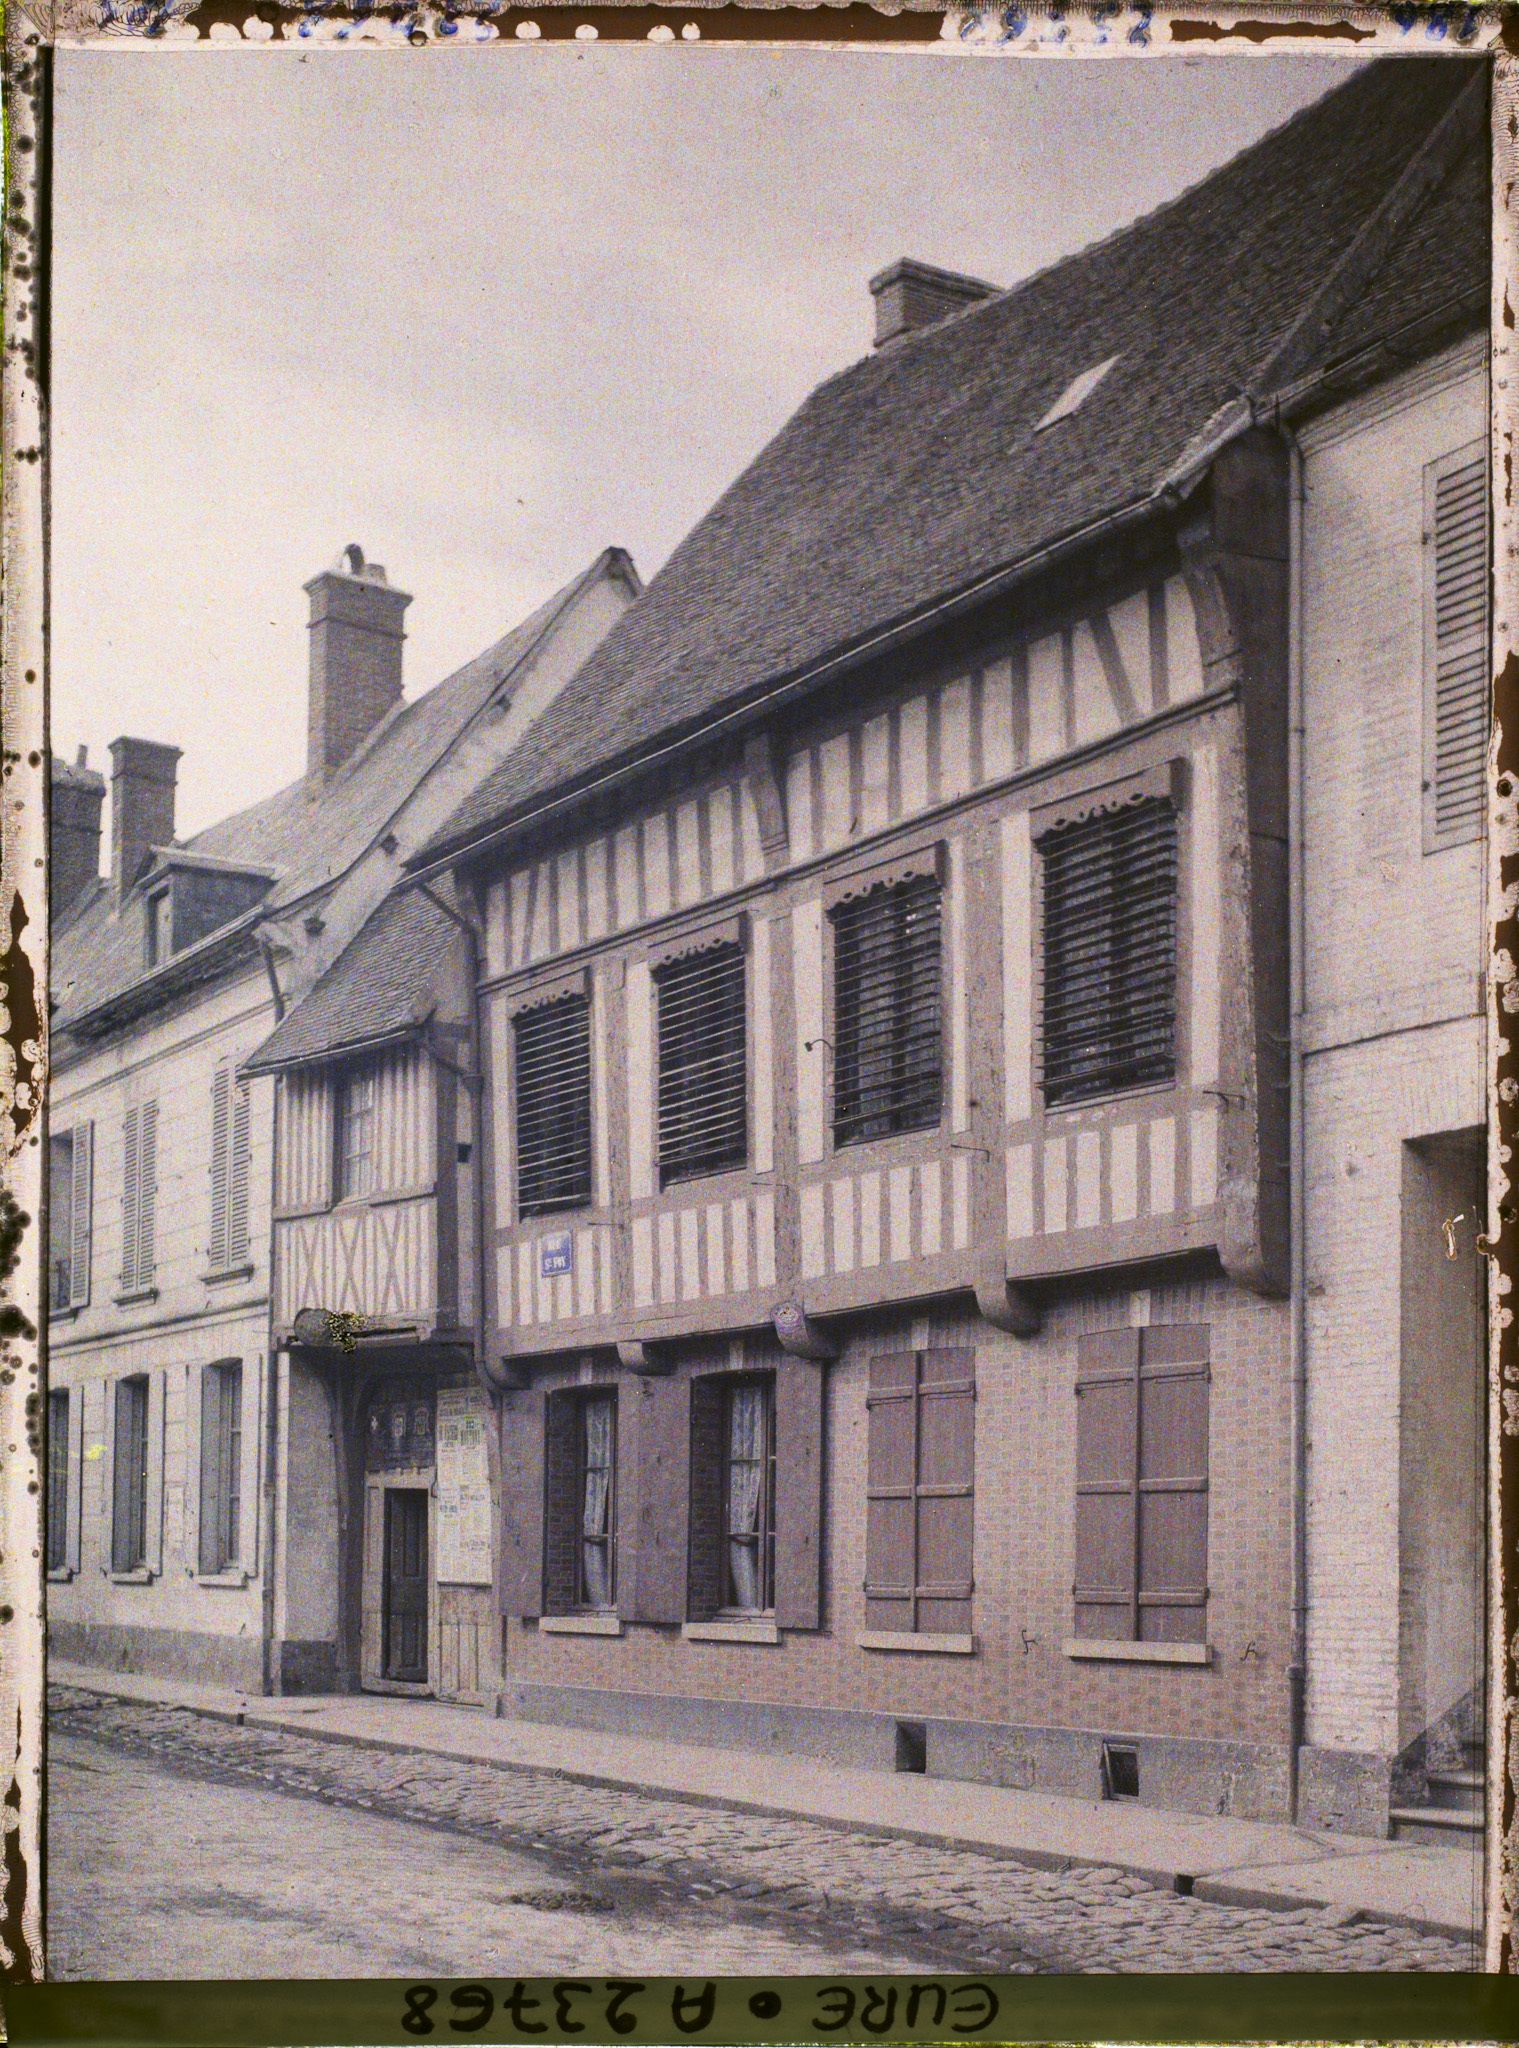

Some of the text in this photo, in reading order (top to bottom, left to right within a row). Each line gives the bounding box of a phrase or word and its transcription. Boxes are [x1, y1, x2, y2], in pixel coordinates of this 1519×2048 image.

[401, 1981, 1000, 2036] EURE A 23768
